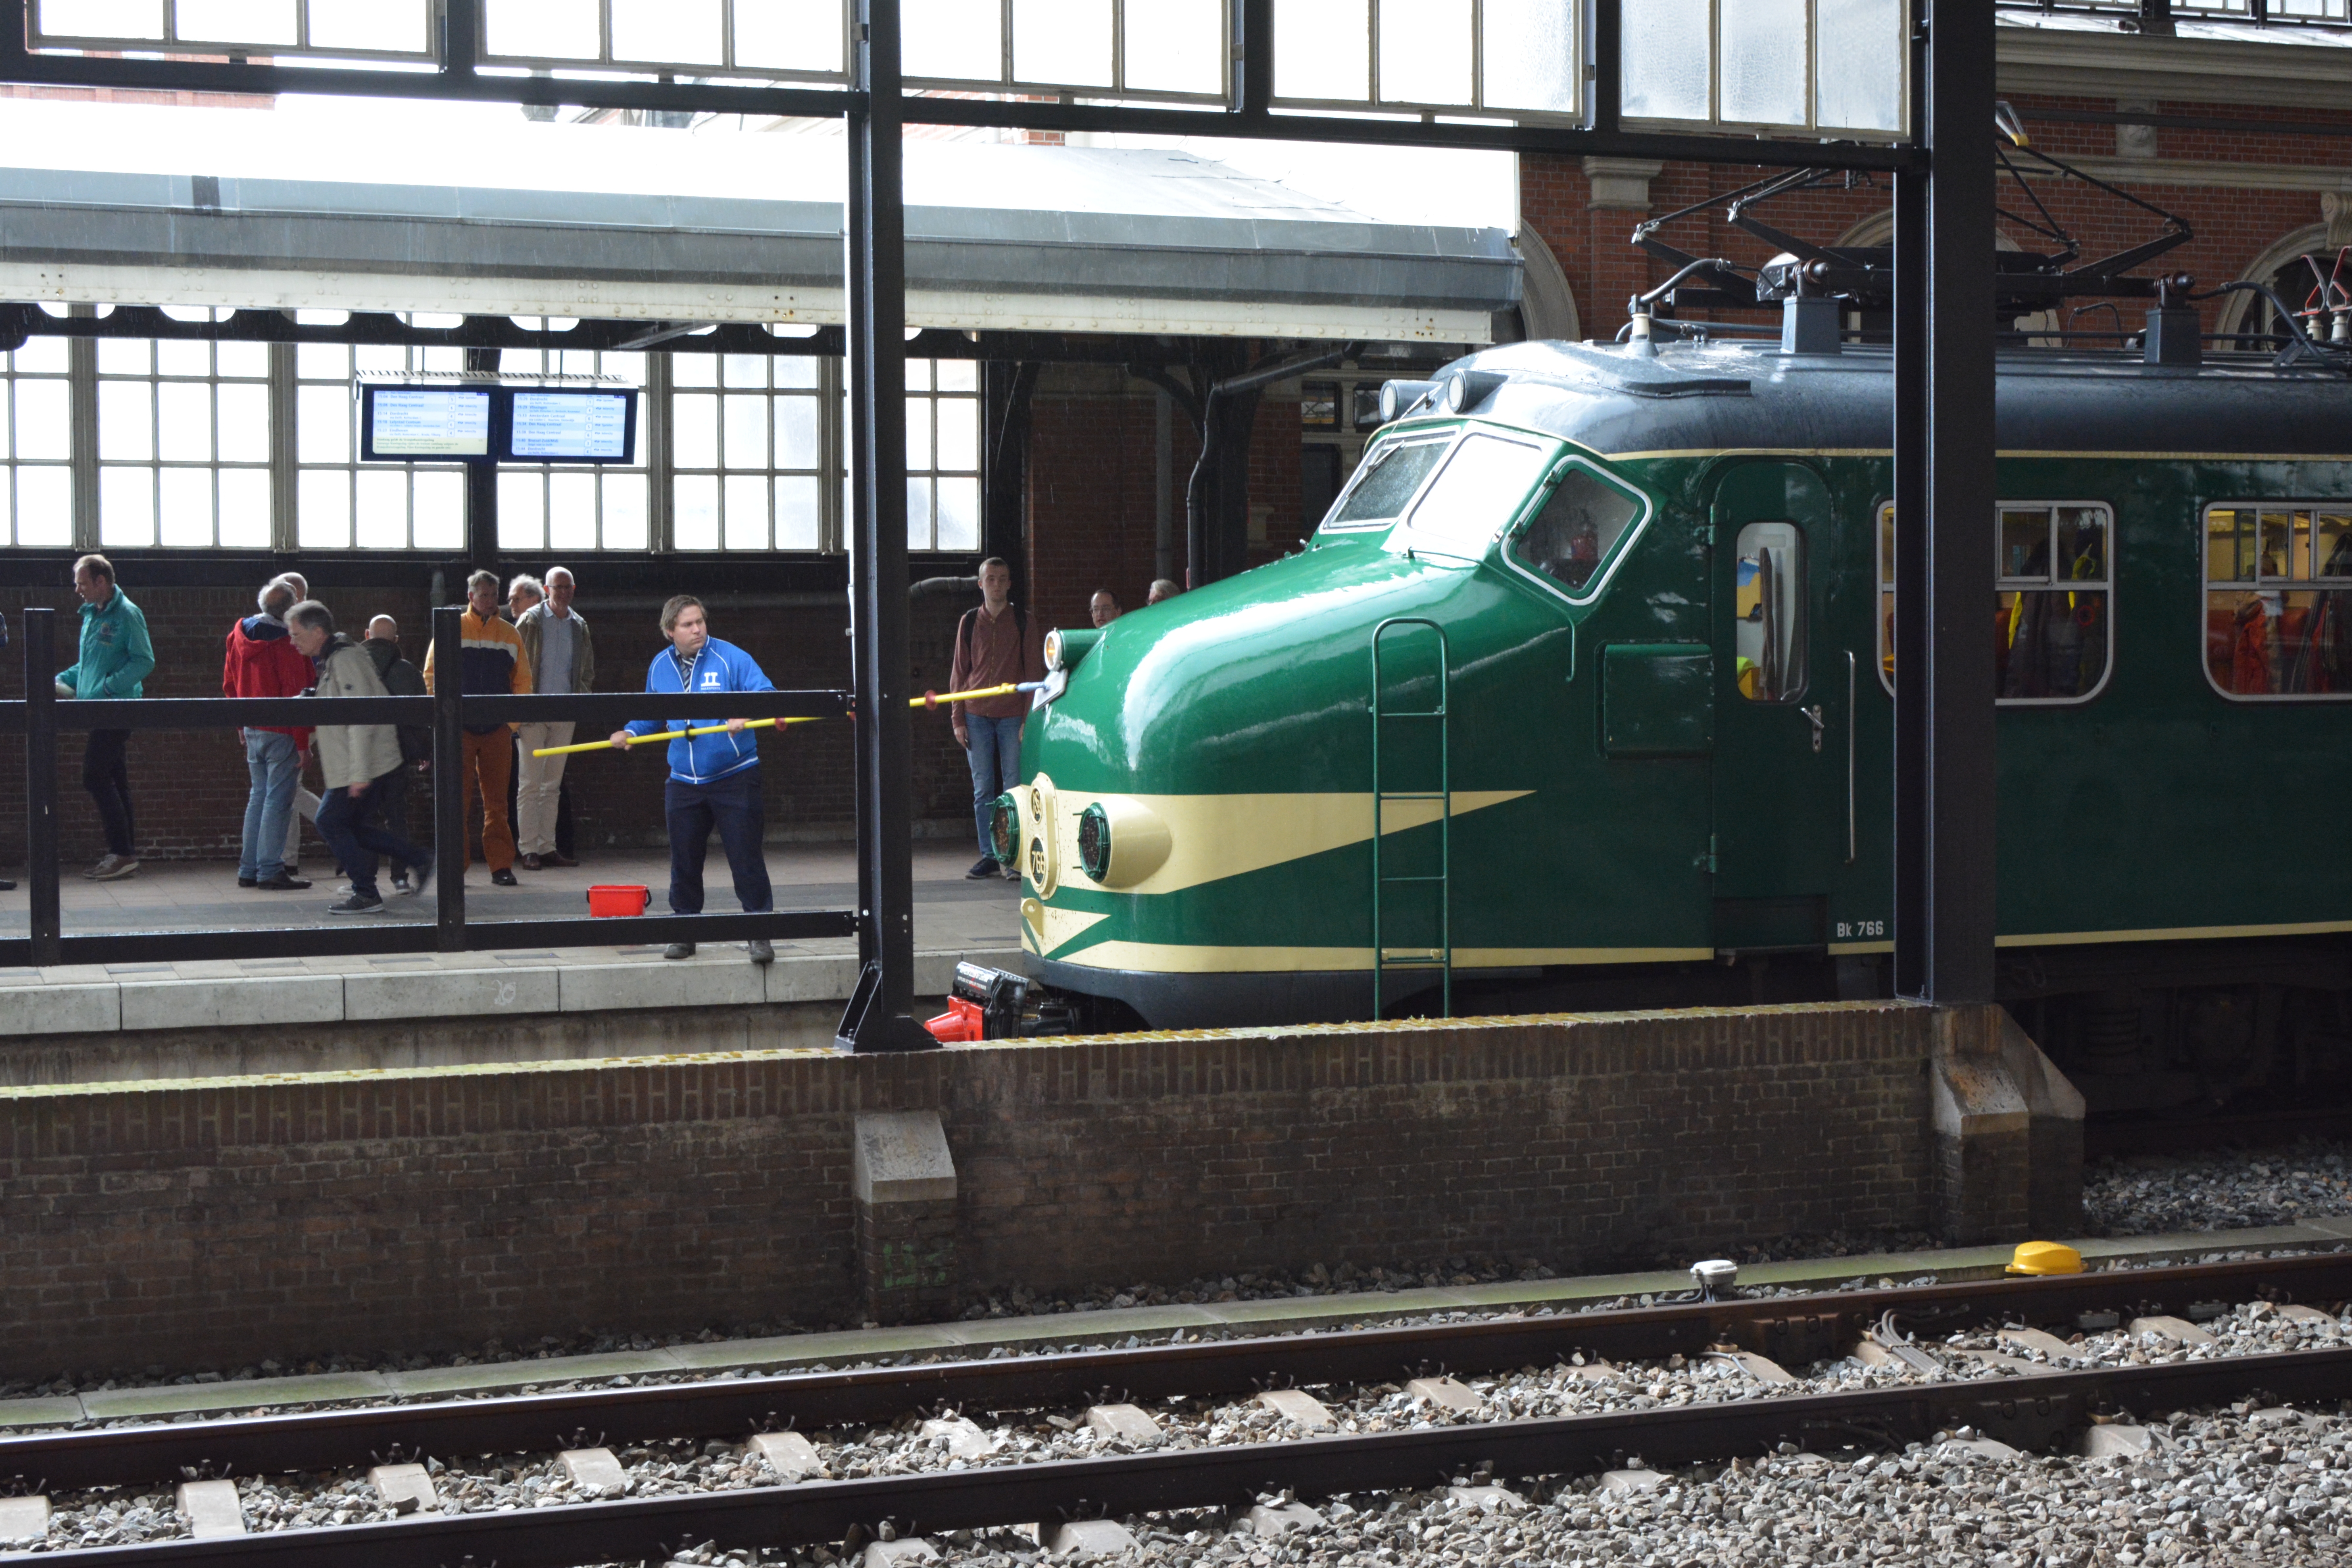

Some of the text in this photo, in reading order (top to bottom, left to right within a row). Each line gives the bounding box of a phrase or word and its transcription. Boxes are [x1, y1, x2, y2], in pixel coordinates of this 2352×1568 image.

[1032, 851, 1045, 874] 766
[1837, 920, 1883, 937] Bk 766
